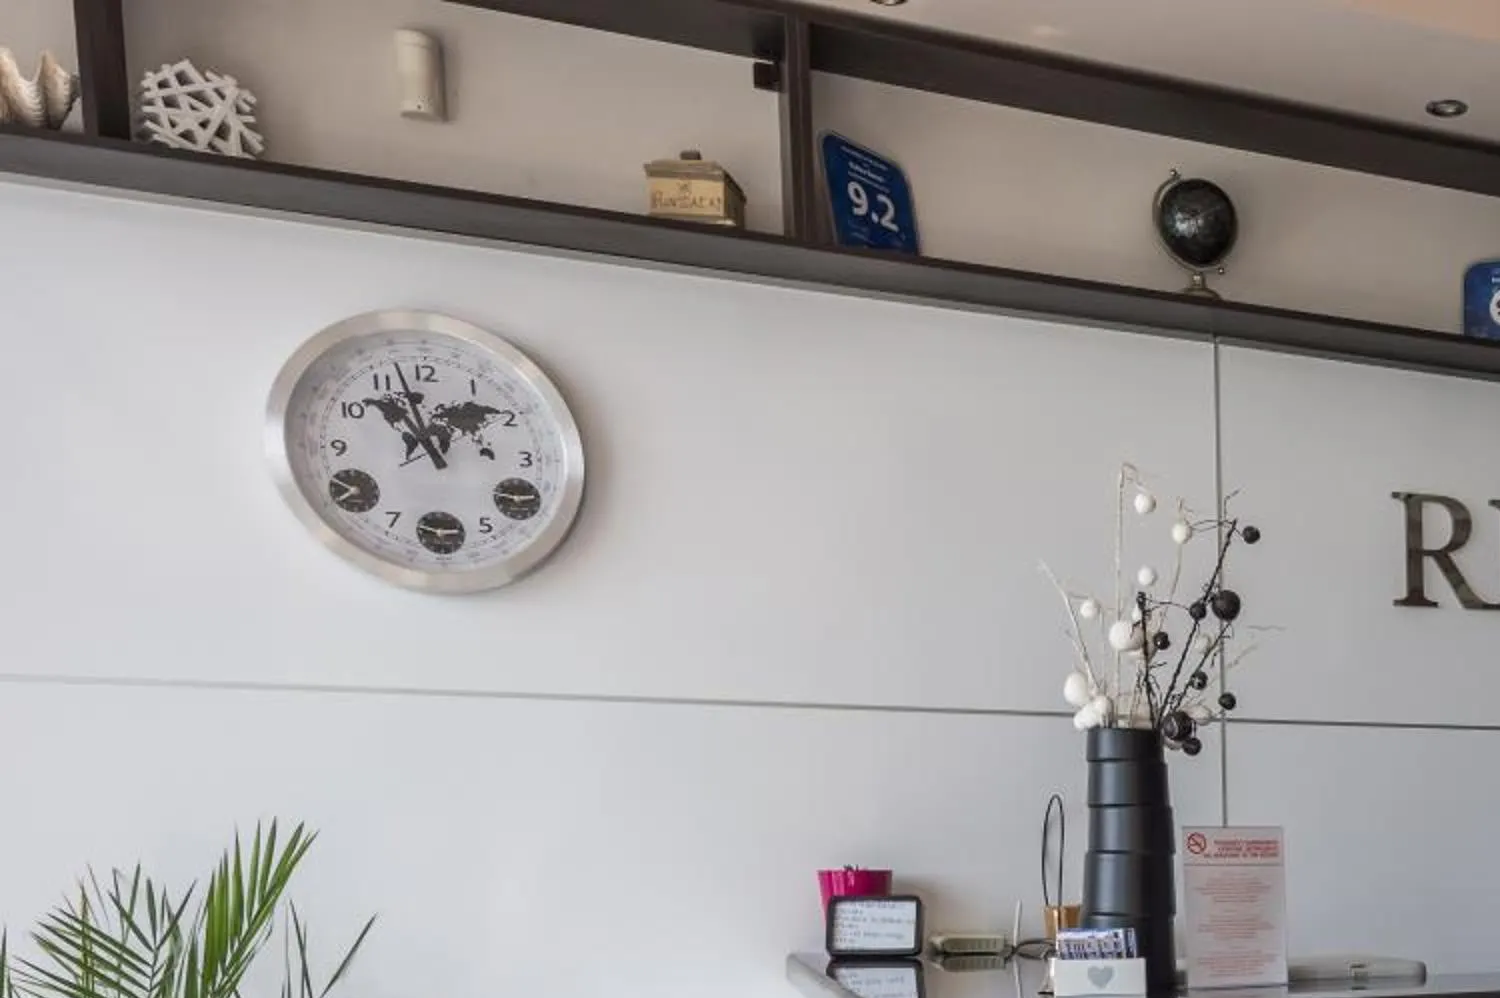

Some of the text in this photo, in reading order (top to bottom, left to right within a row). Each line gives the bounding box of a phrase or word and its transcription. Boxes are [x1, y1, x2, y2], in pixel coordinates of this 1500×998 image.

[847, 181, 899, 232] 9.2
[415, 364, 439, 382] 12
[373, 373, 390, 391] 11
[470, 379, 477, 396] 1
[341, 402, 365, 419] 10
[502, 410, 518, 427] 2
[330, 439, 347, 456] 9
[518, 451, 533, 468] 3
[385, 511, 402, 528] 7
[479, 517, 493, 533] 5
